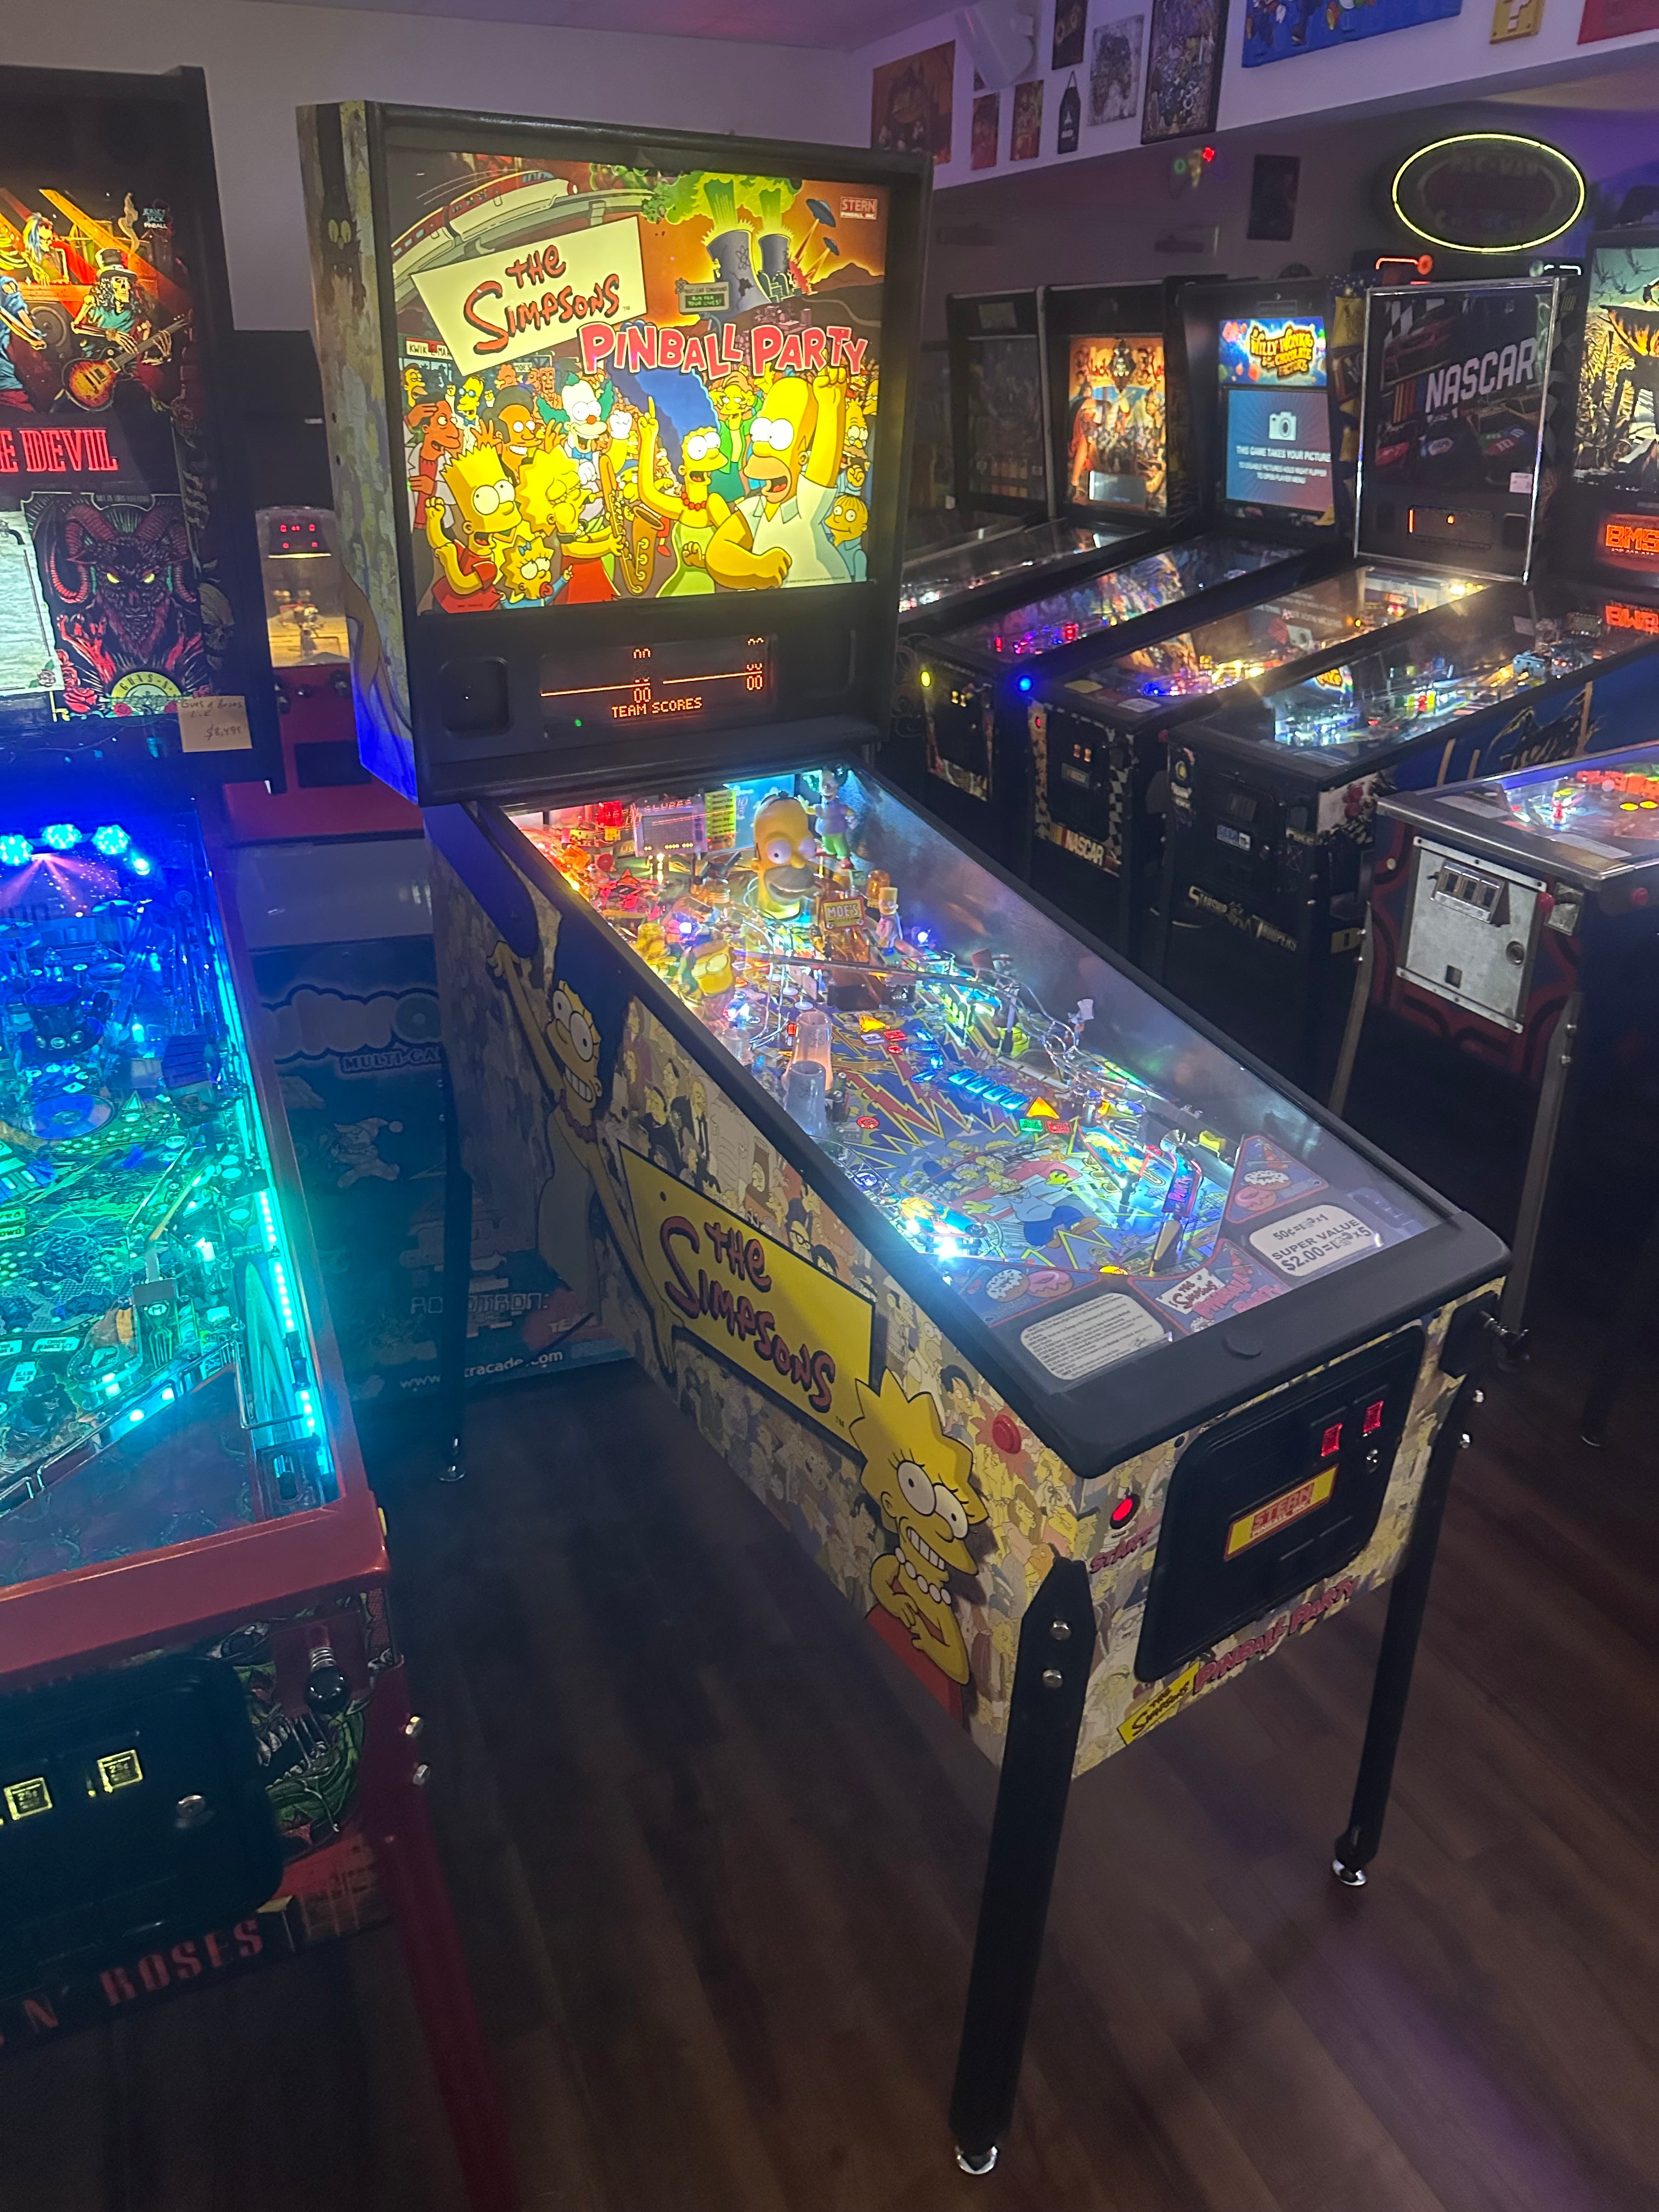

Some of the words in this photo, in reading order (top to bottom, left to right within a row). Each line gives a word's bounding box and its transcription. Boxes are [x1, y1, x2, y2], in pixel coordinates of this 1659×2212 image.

[842, 199, 876, 212] STERN
[409, 344, 427, 354] KWIK
[578, 319, 743, 380] PINBALL
[750, 323, 867, 377] PARTY
[1425, 337, 1537, 413] NASCAR
[19, 429, 119, 472] DEVIL
[611, 703, 647, 718] TEAM
[651, 696, 703, 714] SCORES
[1066, 829, 1105, 867] NASCAR
[826, 904, 859, 918] MOE'S
[1272, 1237, 1317, 1260] SUPER
[1317, 1219, 1361, 1240] VALUE
[660, 1216, 836, 1413] SIMPSONS
[1168, 1280, 1218, 1310] SIMPSONS
[1192, 1273, 1252, 1320] PINBALL
[1252, 1482, 1314, 1529] STERN
[1089, 1526, 1154, 1575] START
[1192, 1614, 1288, 1696] PINBALL
[1288, 1575, 1361, 1637] PARTY
[98, 1920, 264, 2006] ROSES
